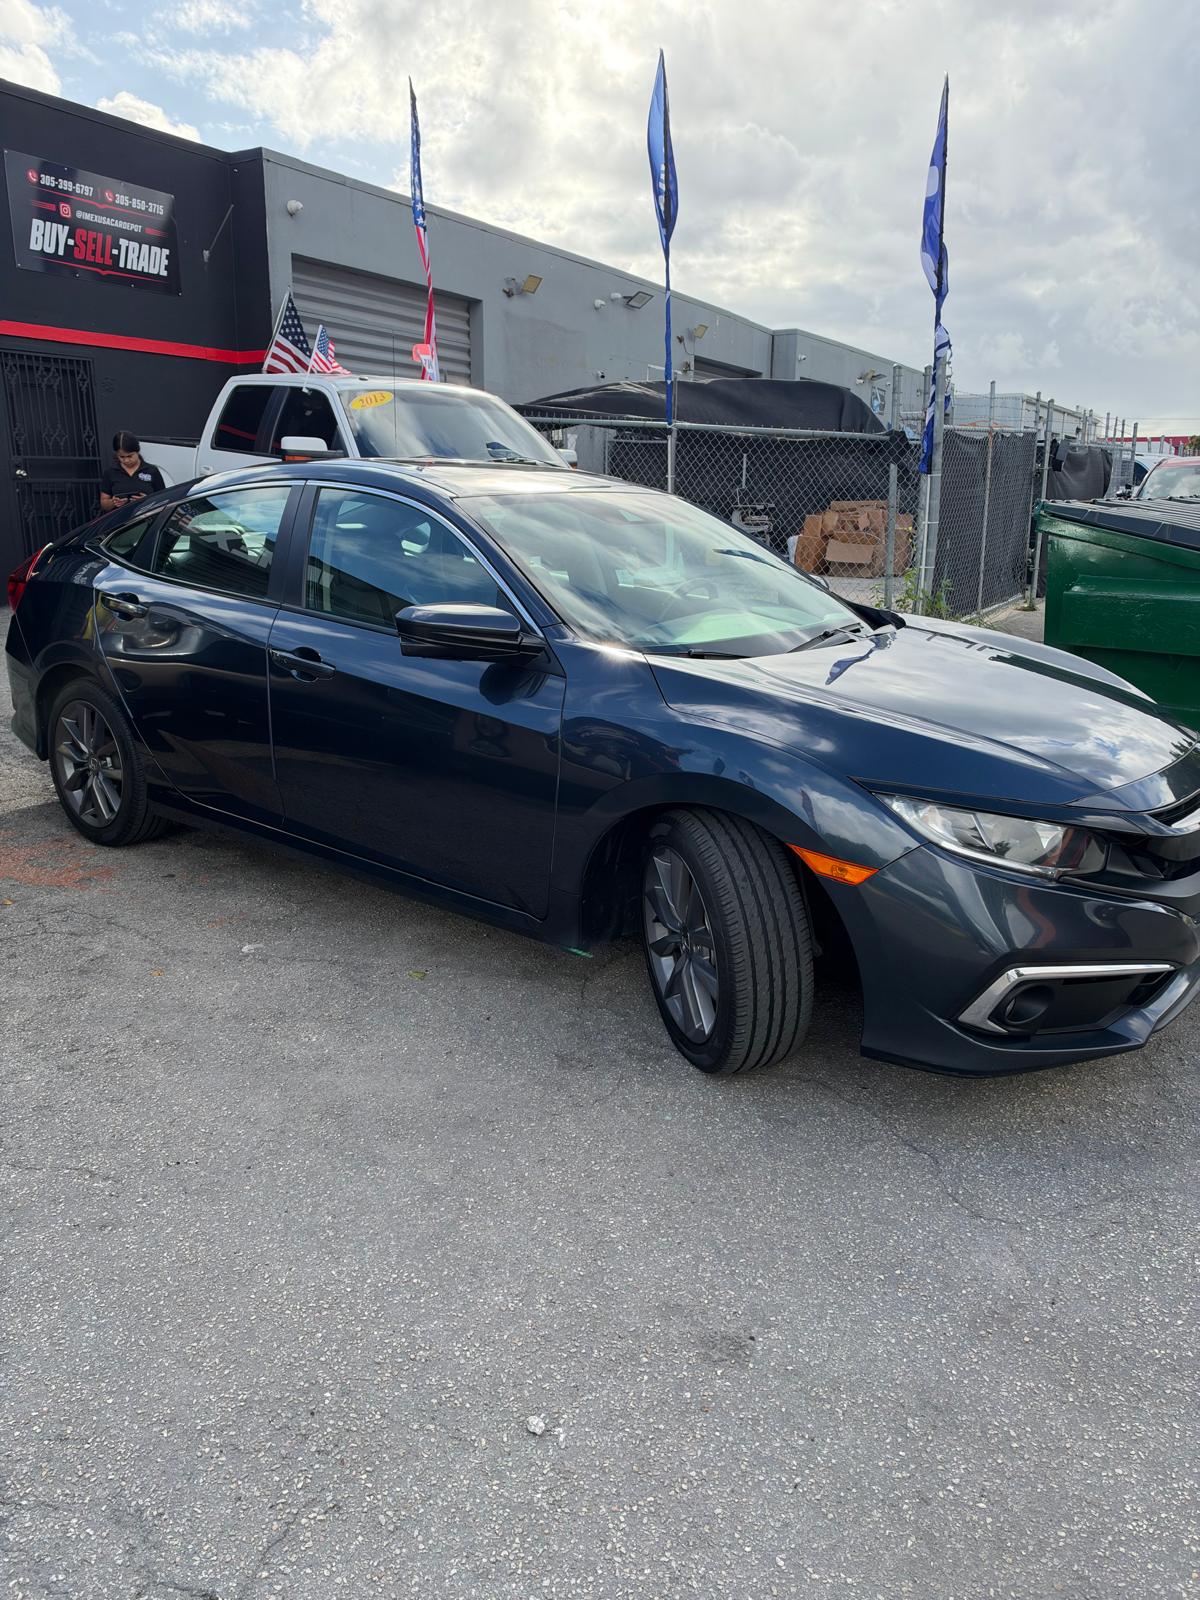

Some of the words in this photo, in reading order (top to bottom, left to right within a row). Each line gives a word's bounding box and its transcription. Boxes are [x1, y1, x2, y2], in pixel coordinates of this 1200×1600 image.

[40, 174, 94, 197] 305-399-6797
[115, 194, 164, 215] 305-850-3715
[75, 210, 142, 232] @IMEXUSACARDEPOT
